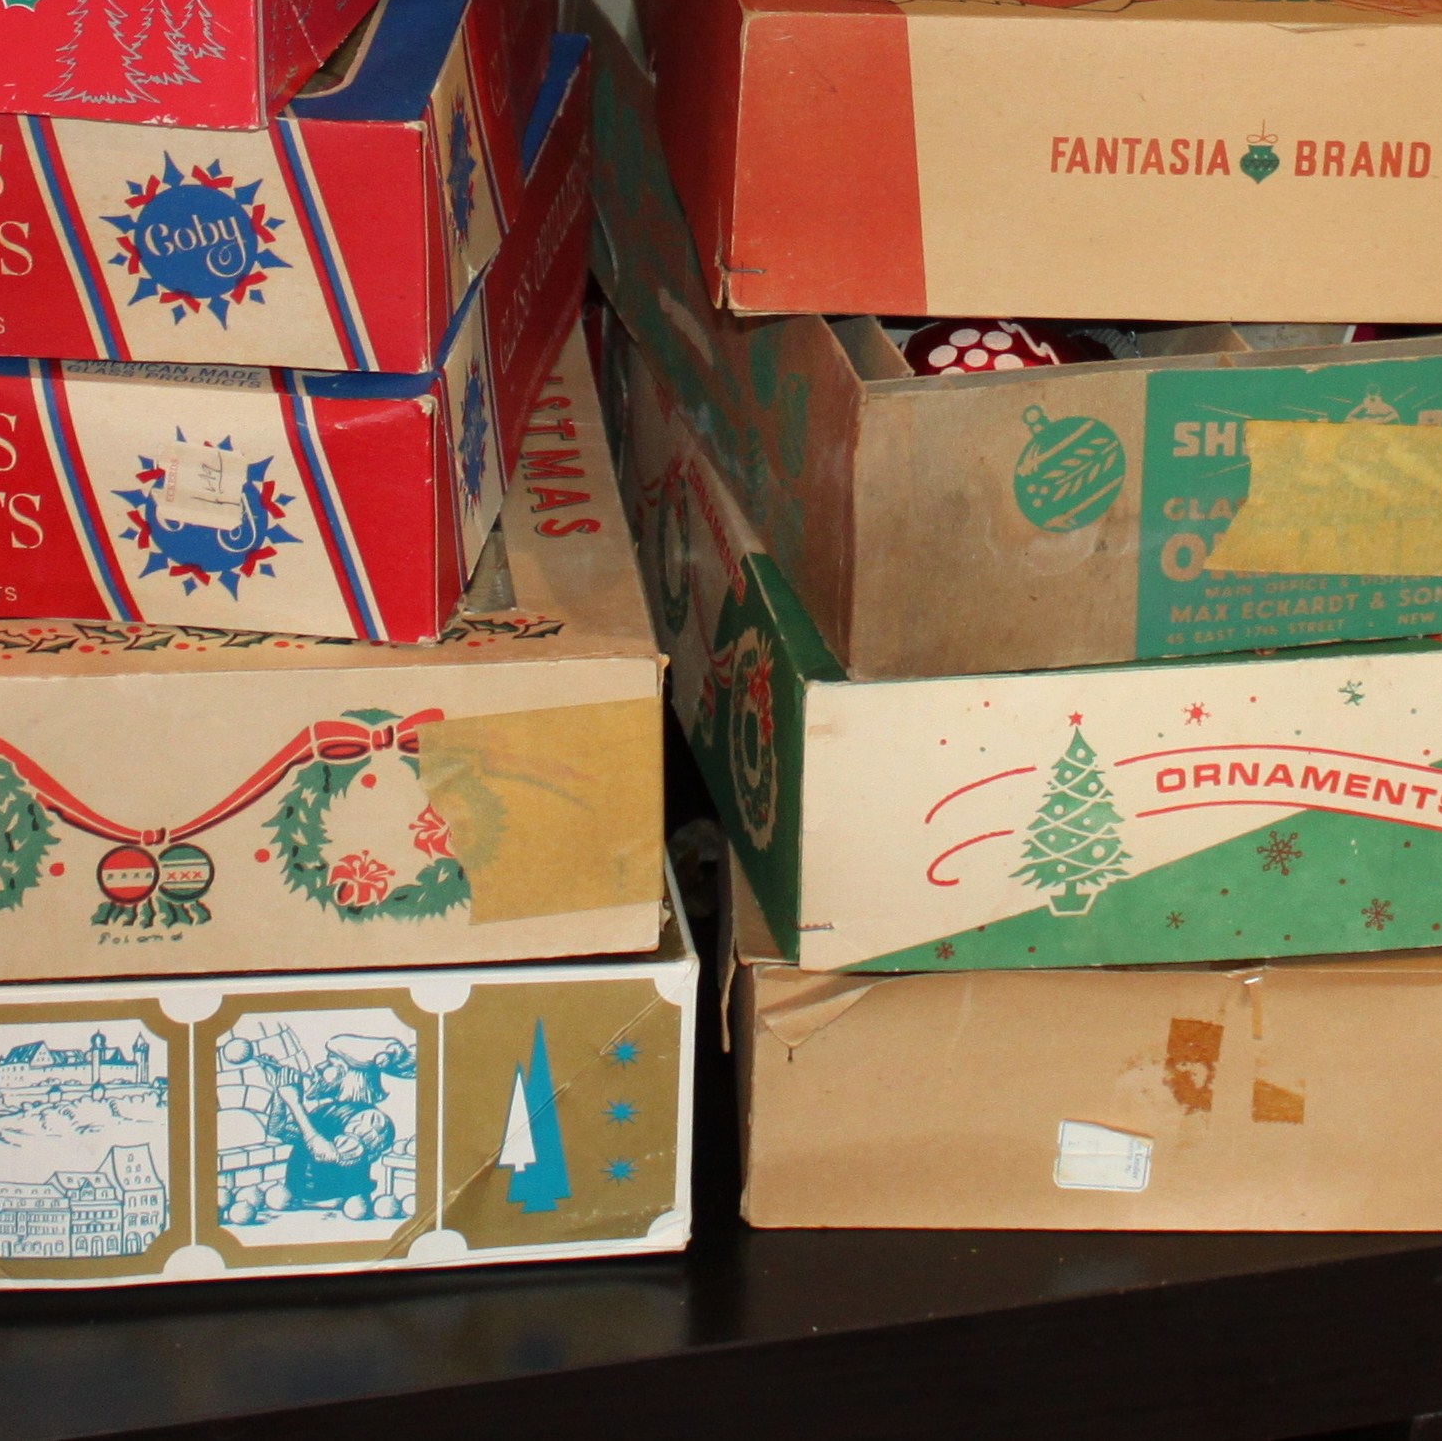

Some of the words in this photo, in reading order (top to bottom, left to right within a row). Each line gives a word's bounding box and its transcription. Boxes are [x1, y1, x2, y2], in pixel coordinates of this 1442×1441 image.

[1050, 136, 1231, 178] FANTASIA
[1293, 139, 1433, 179] BRAND
[146, 210, 247, 279] Coby
[65, 364, 139, 379] GLASS
[145, 372, 260, 389] PRODUCTS
[198, 366, 260, 380] MADE
[1205, 583, 1252, 599] MAIN
[1263, 577, 1327, 594] OFFICE
[1170, 605, 1228, 624] MAX
[1242, 593, 1358, 620] ECKARDT
[1369, 590, 1386, 610] &
[1194, 627, 1234, 643] EAST
[1287, 618, 1345, 635] STREET
[1398, 611, 1435, 626] NEW
